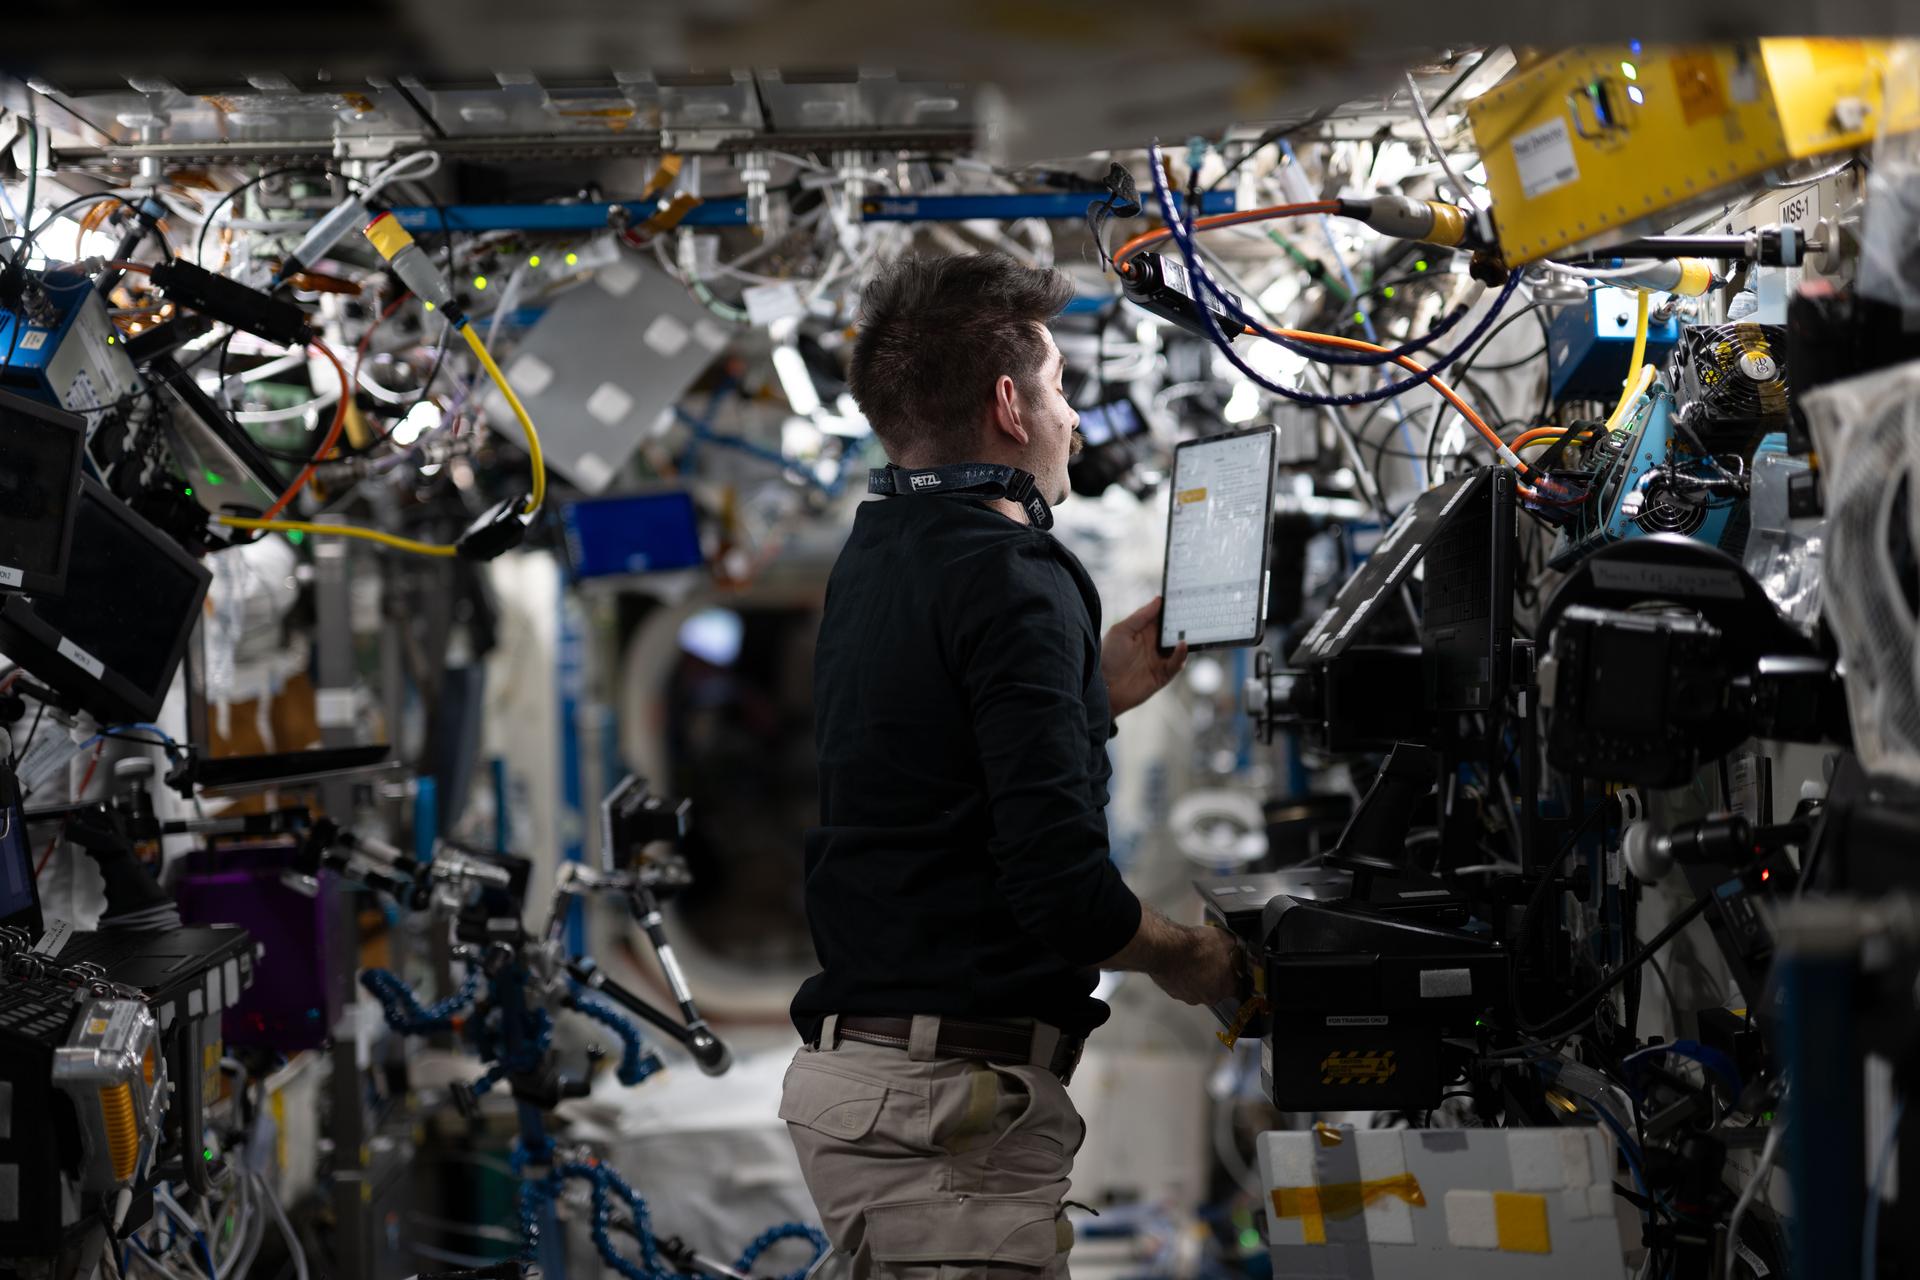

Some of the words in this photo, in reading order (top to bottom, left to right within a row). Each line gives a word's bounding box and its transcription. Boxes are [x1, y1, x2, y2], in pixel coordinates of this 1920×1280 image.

[1782, 196, 1809, 224] MSS-1
[910, 474, 942, 491] PETZL
[1028, 498, 1047, 526] PETZL
[1370, 1016, 1386, 1024] ONLY
